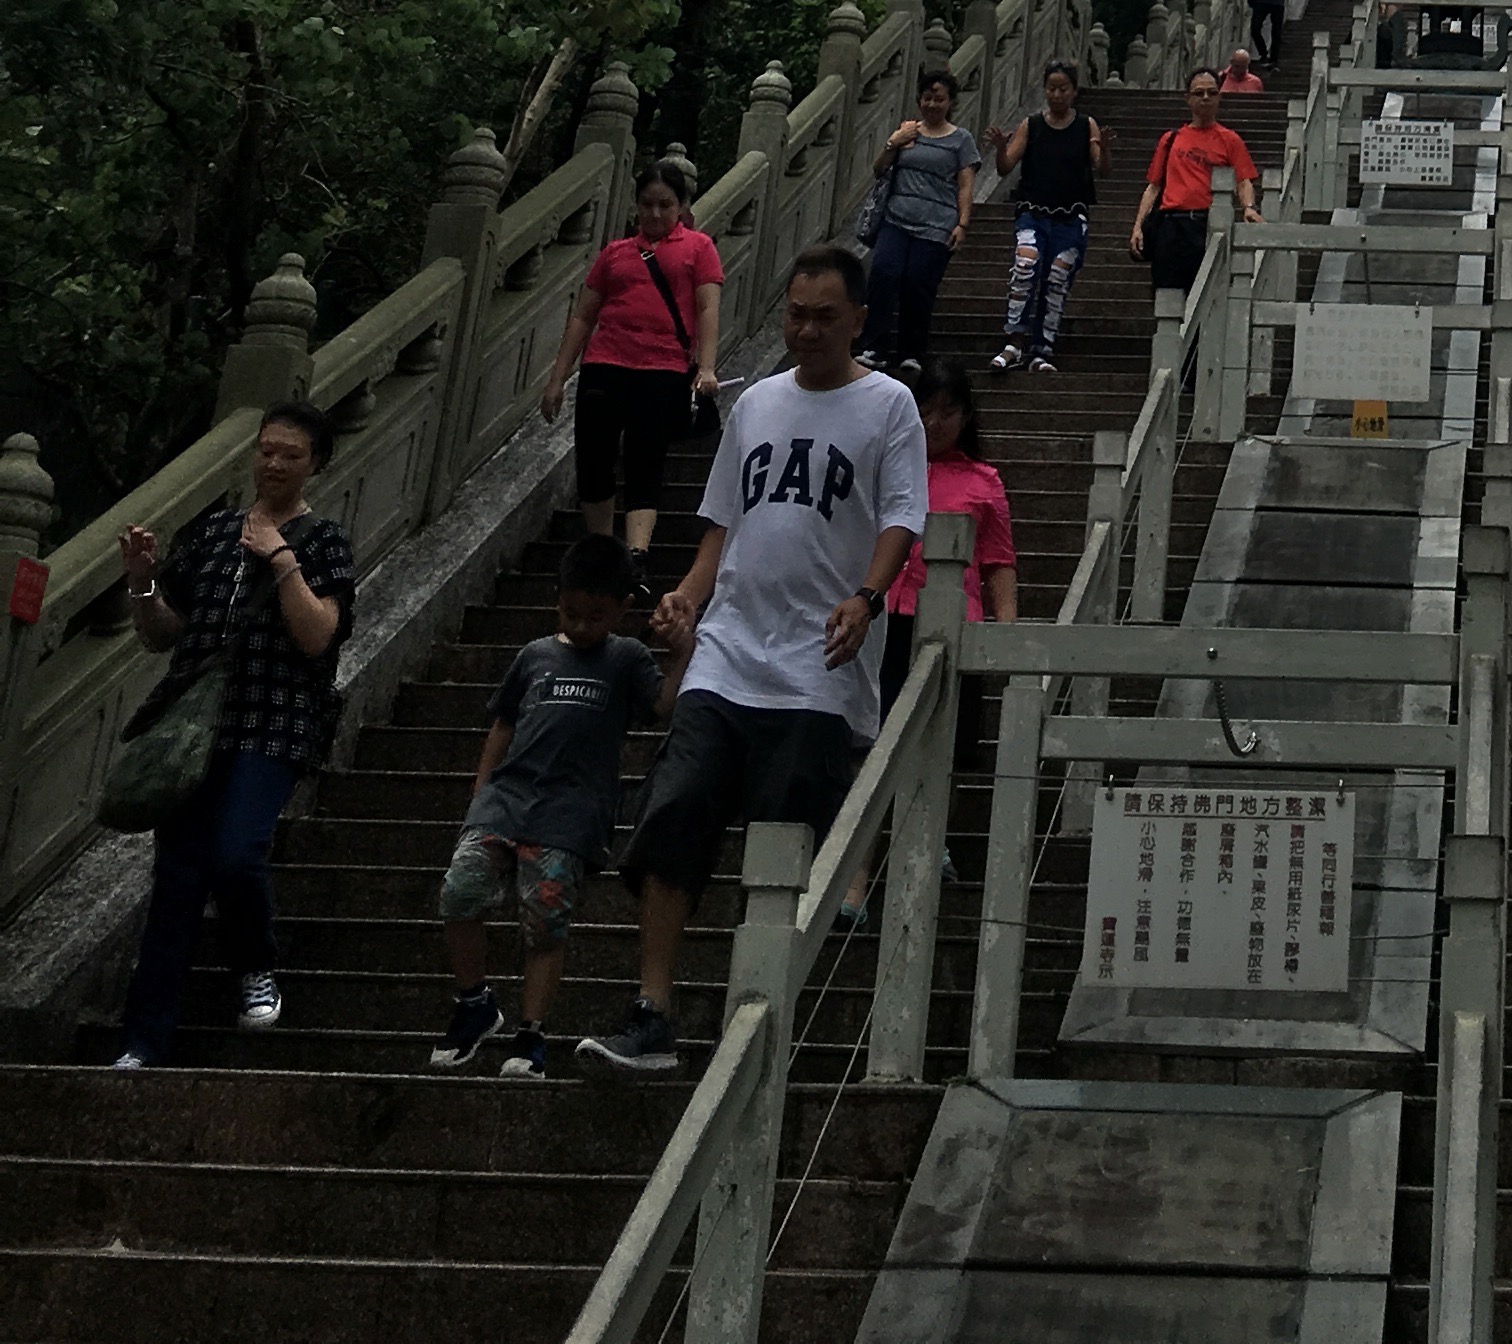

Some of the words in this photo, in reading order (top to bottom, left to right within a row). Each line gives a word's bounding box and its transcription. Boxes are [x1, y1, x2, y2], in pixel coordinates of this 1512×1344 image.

[742, 438, 854, 522] GAP
[1124, 793, 1326, 817] 請保持佛門地方整潔
